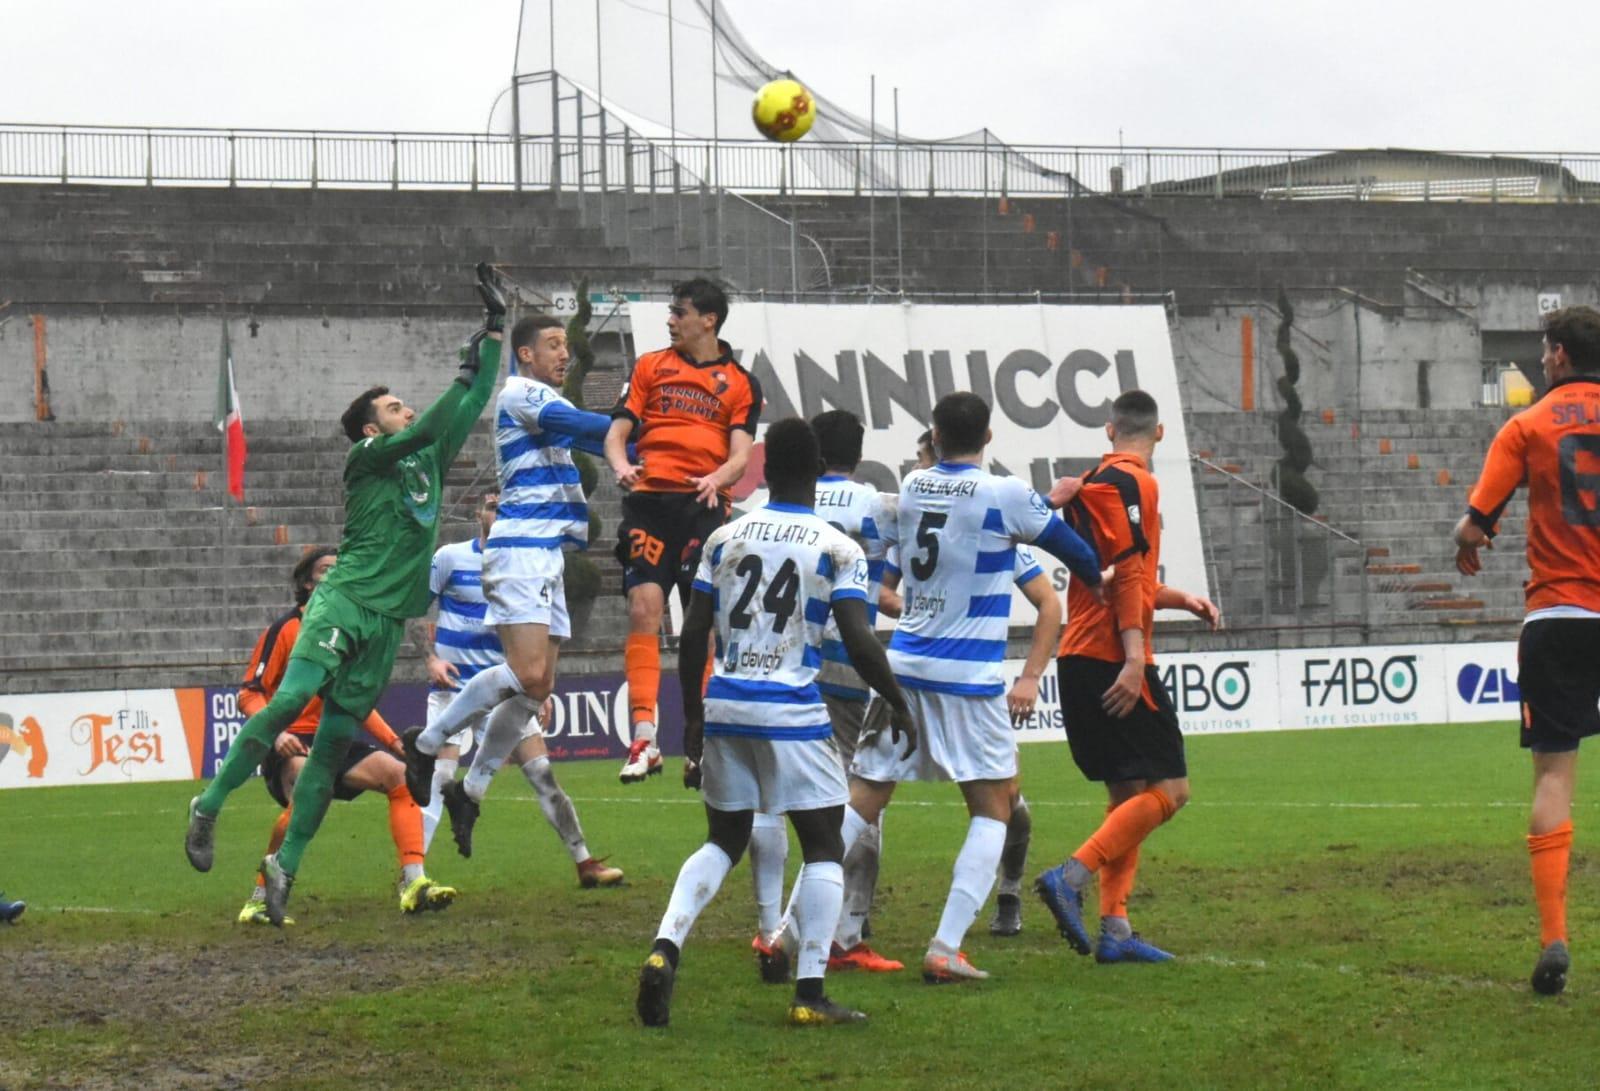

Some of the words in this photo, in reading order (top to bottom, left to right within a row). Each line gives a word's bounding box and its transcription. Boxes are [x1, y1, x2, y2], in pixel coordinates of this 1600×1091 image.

[732, 348, 1142, 430] ANNUCCI
[907, 477, 978, 498] MOLINARI
[628, 527, 665, 567] 28
[732, 521, 775, 542] LATTE
[773, 524, 805, 545] LATH
[910, 510, 949, 582] 5
[539, 583, 549, 602] 4
[728, 553, 800, 634] 24
[1153, 661, 1251, 712] ABO
[1301, 655, 1417, 707] FABO
[1181, 718, 1251, 732] OLUTIONS
[1304, 714, 1336, 726] TAPE
[1343, 711, 1419, 724] SOLUTIONS
